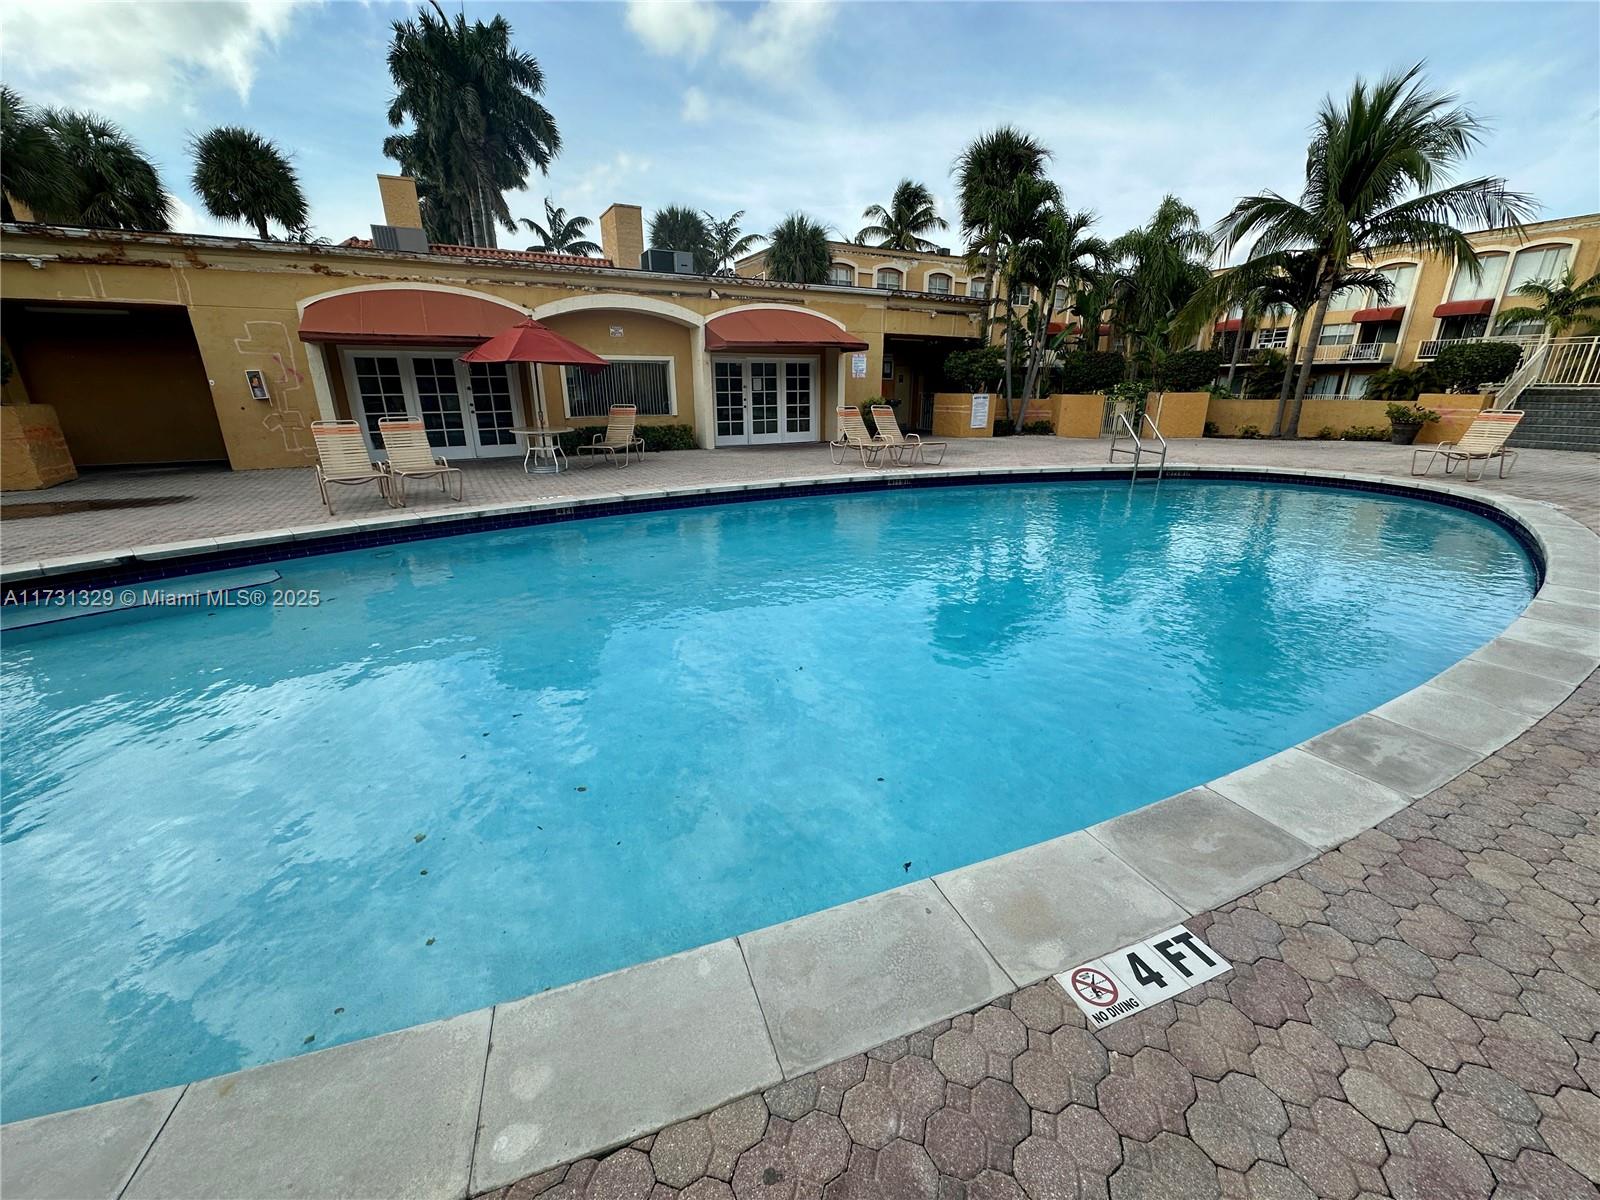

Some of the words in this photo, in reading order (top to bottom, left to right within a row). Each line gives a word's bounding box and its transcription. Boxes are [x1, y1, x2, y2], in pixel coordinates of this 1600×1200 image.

[1126, 952, 1168, 988] 4
[1153, 931, 1217, 978] FT
[1091, 1010, 1109, 1024] NO
[1108, 997, 1140, 1018] DIVING
